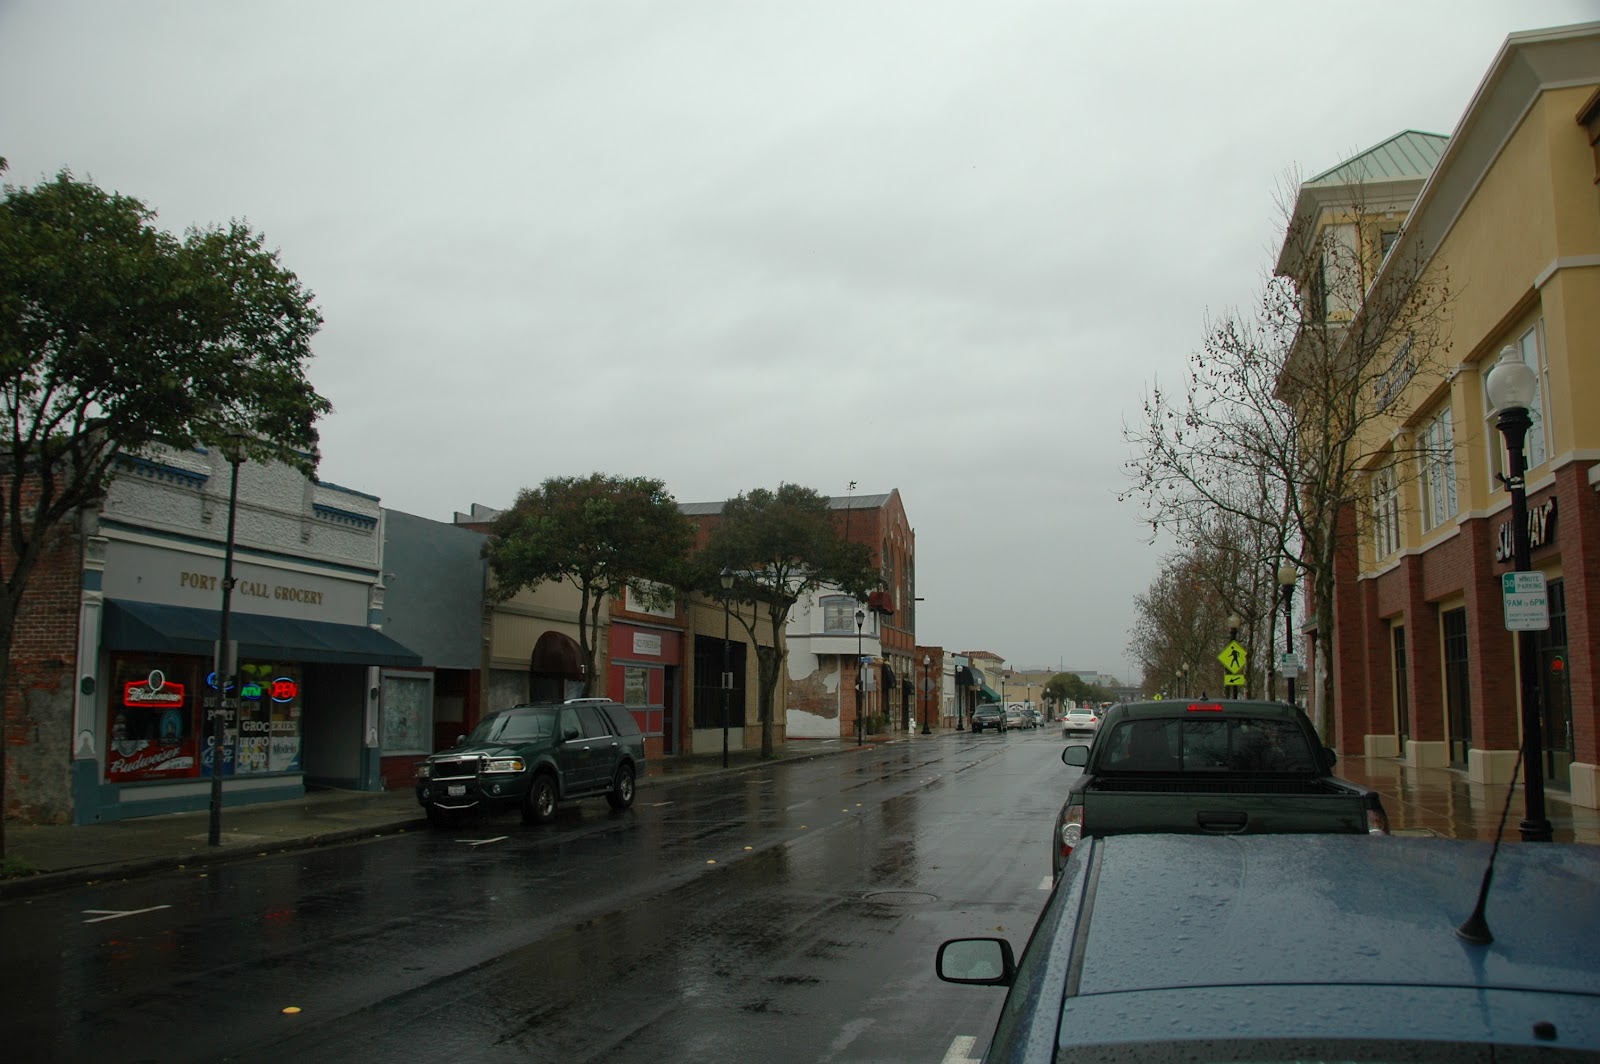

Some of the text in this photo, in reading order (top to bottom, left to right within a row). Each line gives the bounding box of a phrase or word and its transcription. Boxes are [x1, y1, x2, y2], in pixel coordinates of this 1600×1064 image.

[1495, 498, 1556, 562] SUAY
[1504, 580, 1515, 588] 30
[1518, 575, 1540, 583] MINUTE
[180, 571, 217, 591] PORT
[240, 580, 271, 599] CALL
[274, 585, 324, 606] GROCERY
[1517, 582, 1543, 590] PARKING
[1506, 599, 1523, 607] 9AM
[1529, 598, 1546, 606] 6PM
[128, 687, 181, 702] Budweiser
[241, 686, 262, 697] ATM
[268, 681, 298, 698] OPEN
[203, 697, 238, 708] SUUN
[207, 710, 235, 721] PRT
[110, 747, 181, 773] Budweiser
[240, 752, 267, 763] FOOD
